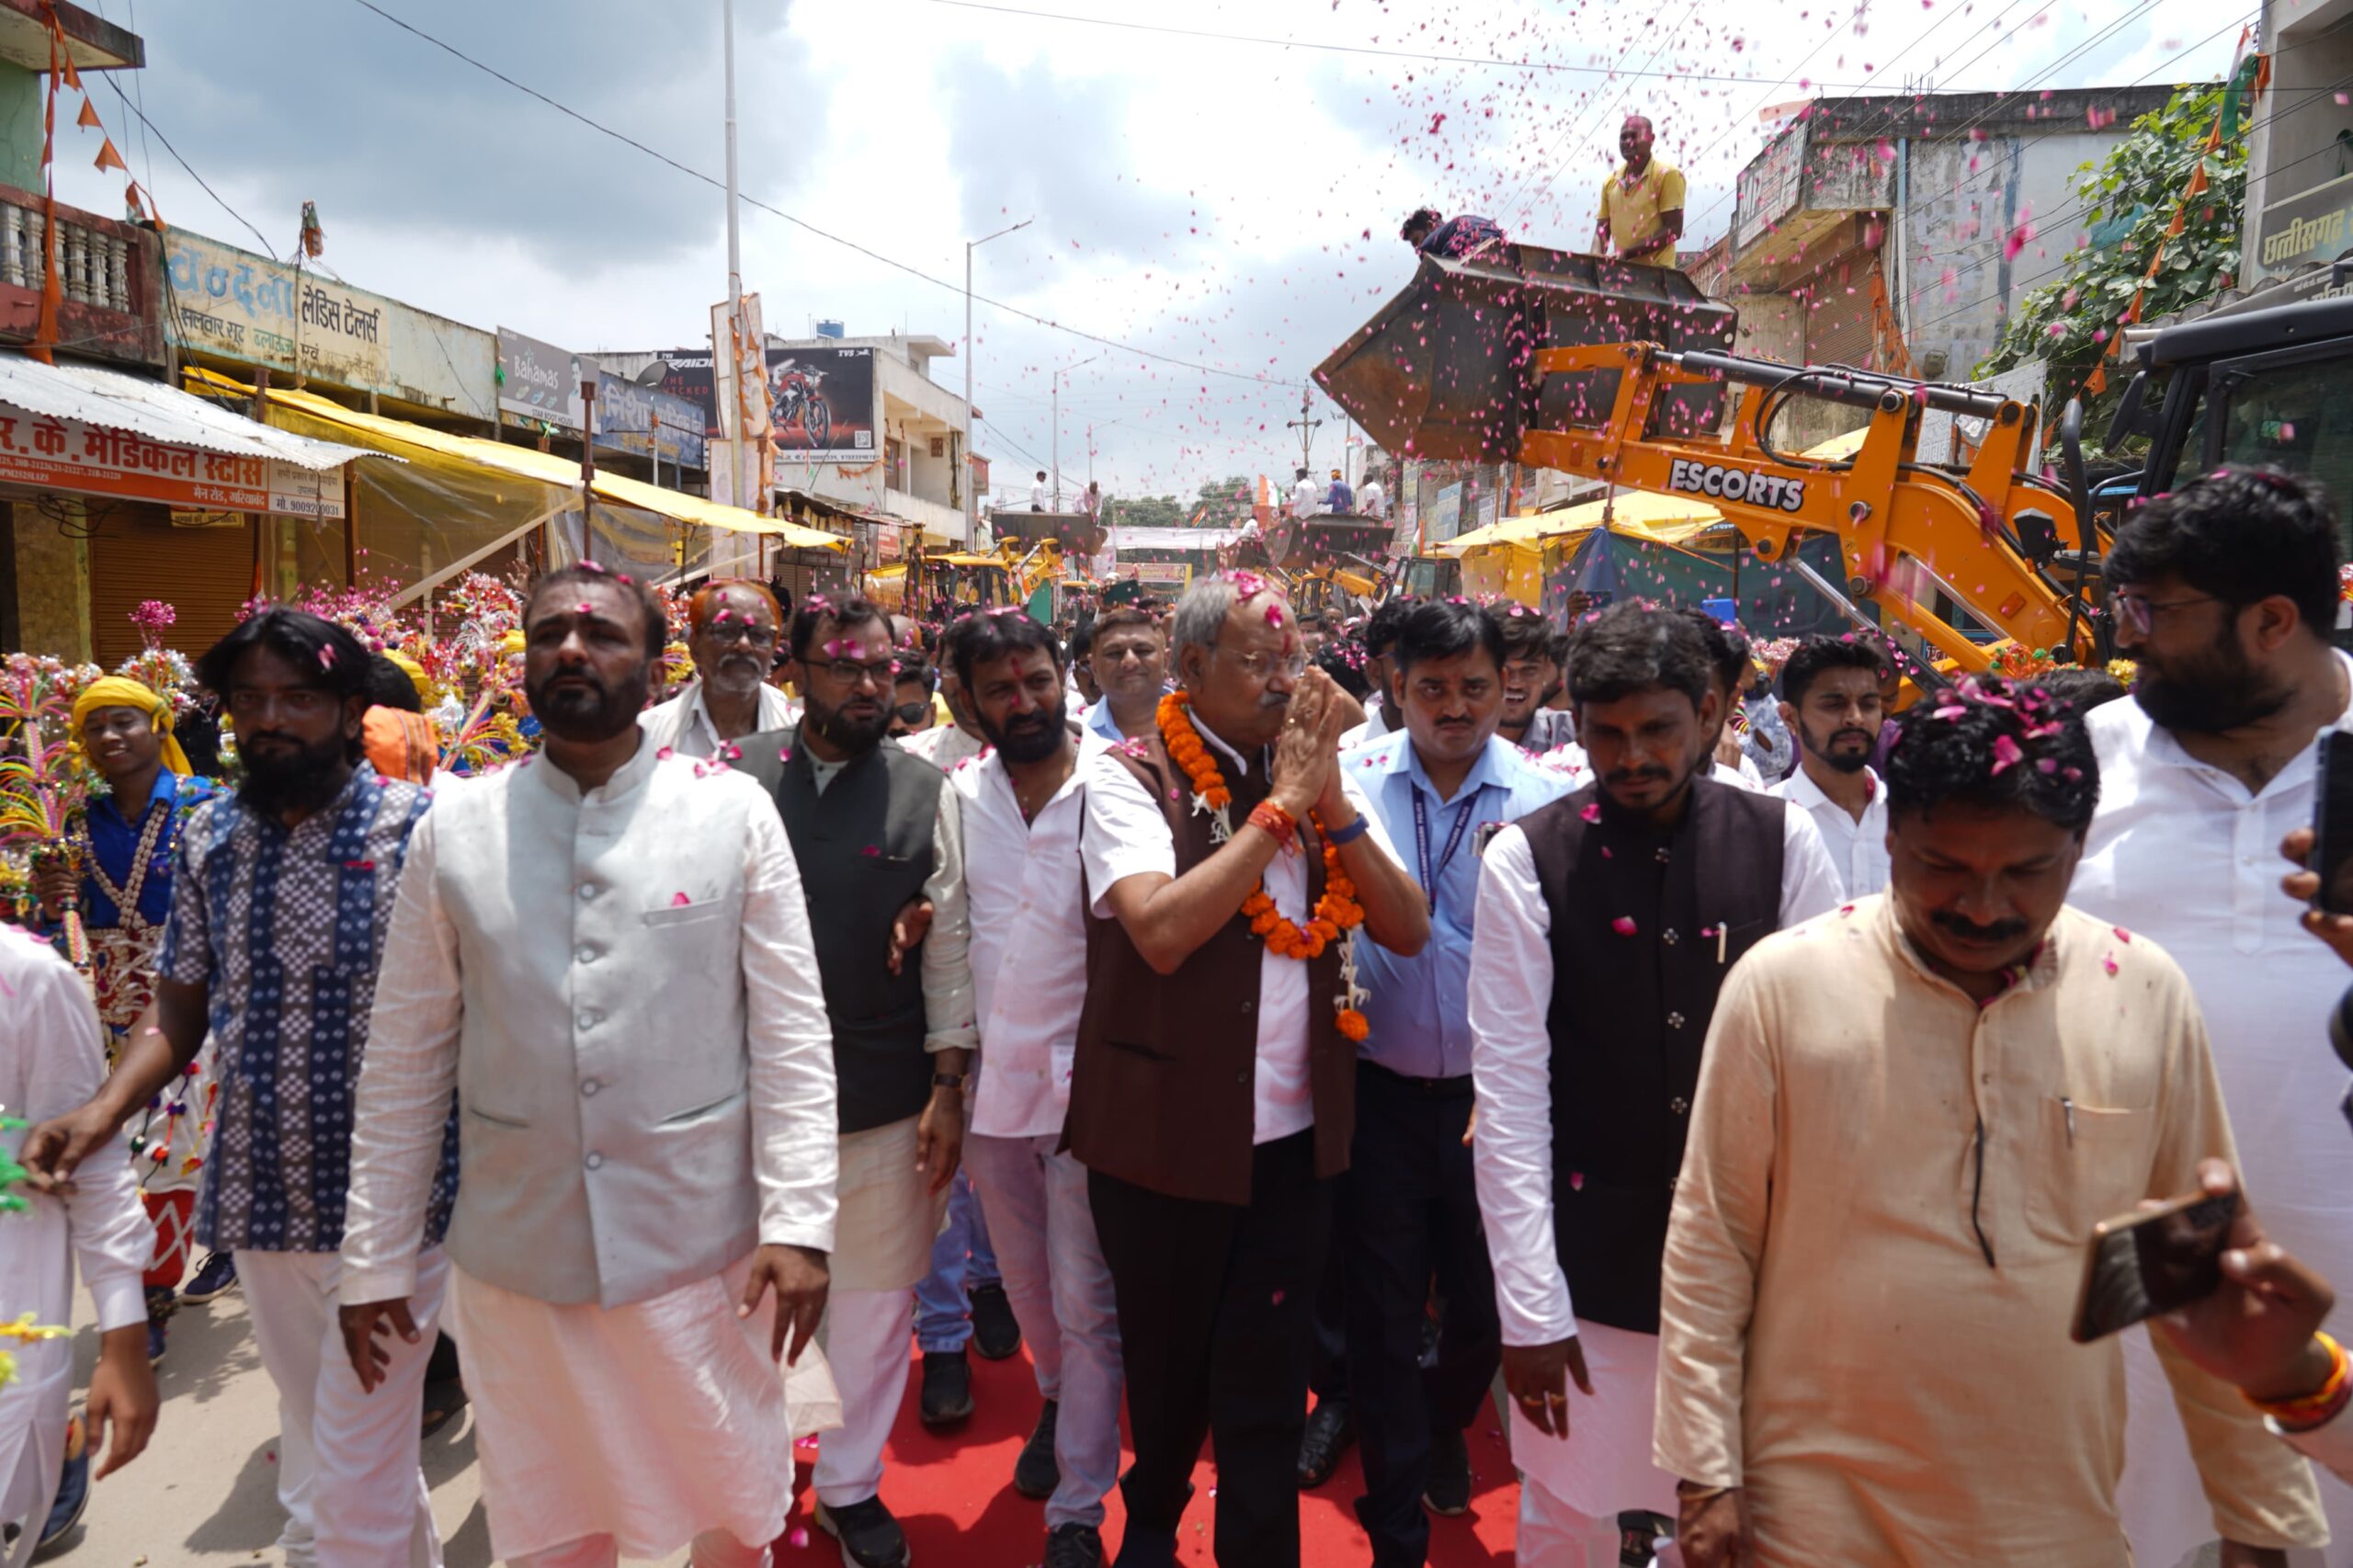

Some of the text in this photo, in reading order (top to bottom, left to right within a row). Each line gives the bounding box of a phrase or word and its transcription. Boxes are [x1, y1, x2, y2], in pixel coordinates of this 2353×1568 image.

[666, 358, 713, 371] RAID
[193, 483, 209, 501] मेन
[229, 490, 266, 506] गरियाबंद
[1669, 459, 1804, 511] ESCORTS
[276, 494, 289, 511] मो.
[1415, 801, 1424, 824] POLICE
